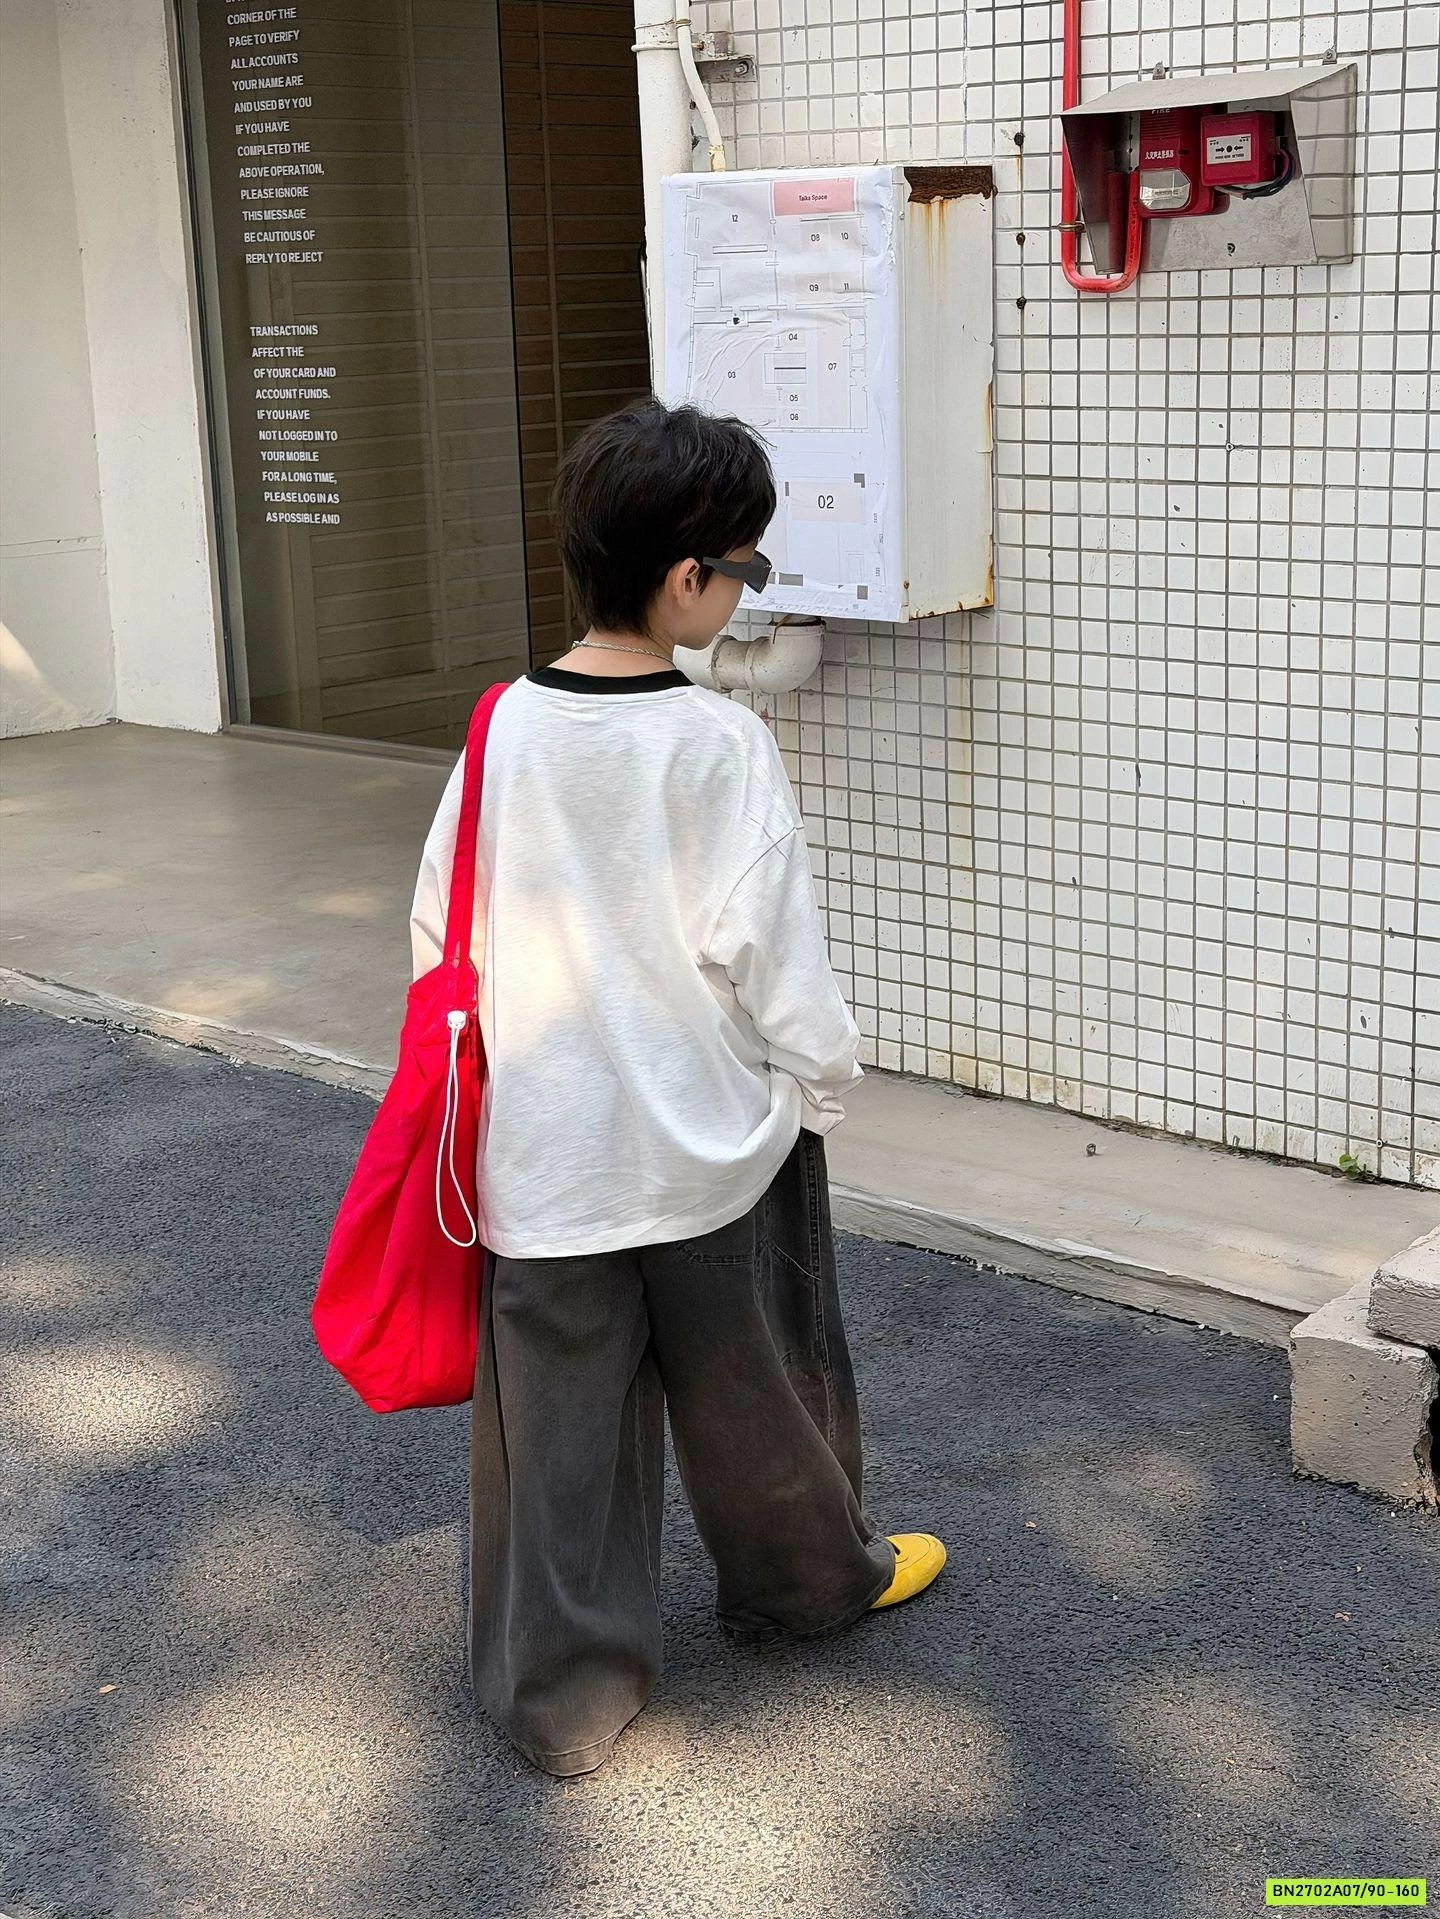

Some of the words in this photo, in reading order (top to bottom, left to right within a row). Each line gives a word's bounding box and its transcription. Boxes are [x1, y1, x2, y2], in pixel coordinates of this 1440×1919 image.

[227, 12, 264, 25] CORNER
[265, 10, 277, 20] OF
[278, 8, 296, 19] THE
[229, 35, 253, 47] PAGE
[254, 34, 266, 44] TO
[267, 30, 300, 43] VERIFY
[231, 58, 248, 69] ALL
[249, 53, 298, 68] ACCOUNTS
[232, 80, 257, 91] YOUR
[259, 77, 284, 89] NAME
[285, 75, 303, 87] ARE
[235, 102, 253, 113] AND
[254, 100, 277, 111] USED
[278, 99, 292, 110] BY
[292, 97, 311, 108] YOU
[235, 125, 243, 134] IF
[245, 123, 264, 134] YOU
[265, 121, 289, 132] HAVE
[238, 143, 290, 156] COMPLETED
[292, 142, 310, 153] THE
[239, 167, 270, 178] ABOVE
[271, 164, 324, 176] OPERATION,
[241, 188, 274, 200] PLEASE
[276, 187, 309, 198] IGNORE
[811, 194, 828, 202] Space
[242, 211, 263, 221] THIS
[264, 209, 306, 220] MESSAGE
[731, 214, 739, 222] 12
[244, 232, 256, 242] BE
[257, 231, 302, 242] CAUTIOUS
[303, 230, 315, 240] OF
[840, 232, 849, 240] 10
[245, 254, 273, 263] REPLY
[275, 253, 287, 263] TO
[289, 252, 323, 262] REJECT
[809, 284, 819, 292] 09
[843, 283, 850, 291] 11
[250, 325, 318, 336] TRANSACTIONS
[788, 333, 798, 341] 04
[252, 347, 284, 357] AFFECT
[286, 347, 304, 357] THE
[827, 362, 837, 371] 07
[254, 368, 266, 378] OF
[266, 368, 291, 378] YOUR
[292, 368, 316, 377] CARD
[317, 367, 336, 377] AND
[727, 371, 736, 379] 03
[256, 389, 297, 399] ACCOUNT
[299, 389, 331, 398] FUNDS.
[789, 394, 799, 402] 05
[257, 410, 265, 419] IF
[265, 410, 285, 419] YOU
[286, 410, 310, 419] HAVE
[259, 430, 277, 440] NOT
[279, 431, 313, 440] LOGGED
[325, 431, 338, 440] TO
[261, 451, 285, 461] YOUR
[286, 452, 319, 461] MOBILE
[262, 471, 280, 481] FOR
[281, 472, 287, 481] A
[288, 472, 312, 482] LONG
[313, 472, 337, 484] TIME,
[264, 492, 297, 502] PLEASE
[327, 494, 339, 503] AS
[817, 495, 835, 509] 02
[266, 512, 278, 522] AS
[279, 513, 321, 523] POSSIBLE
[322, 514, 340, 524] AND
